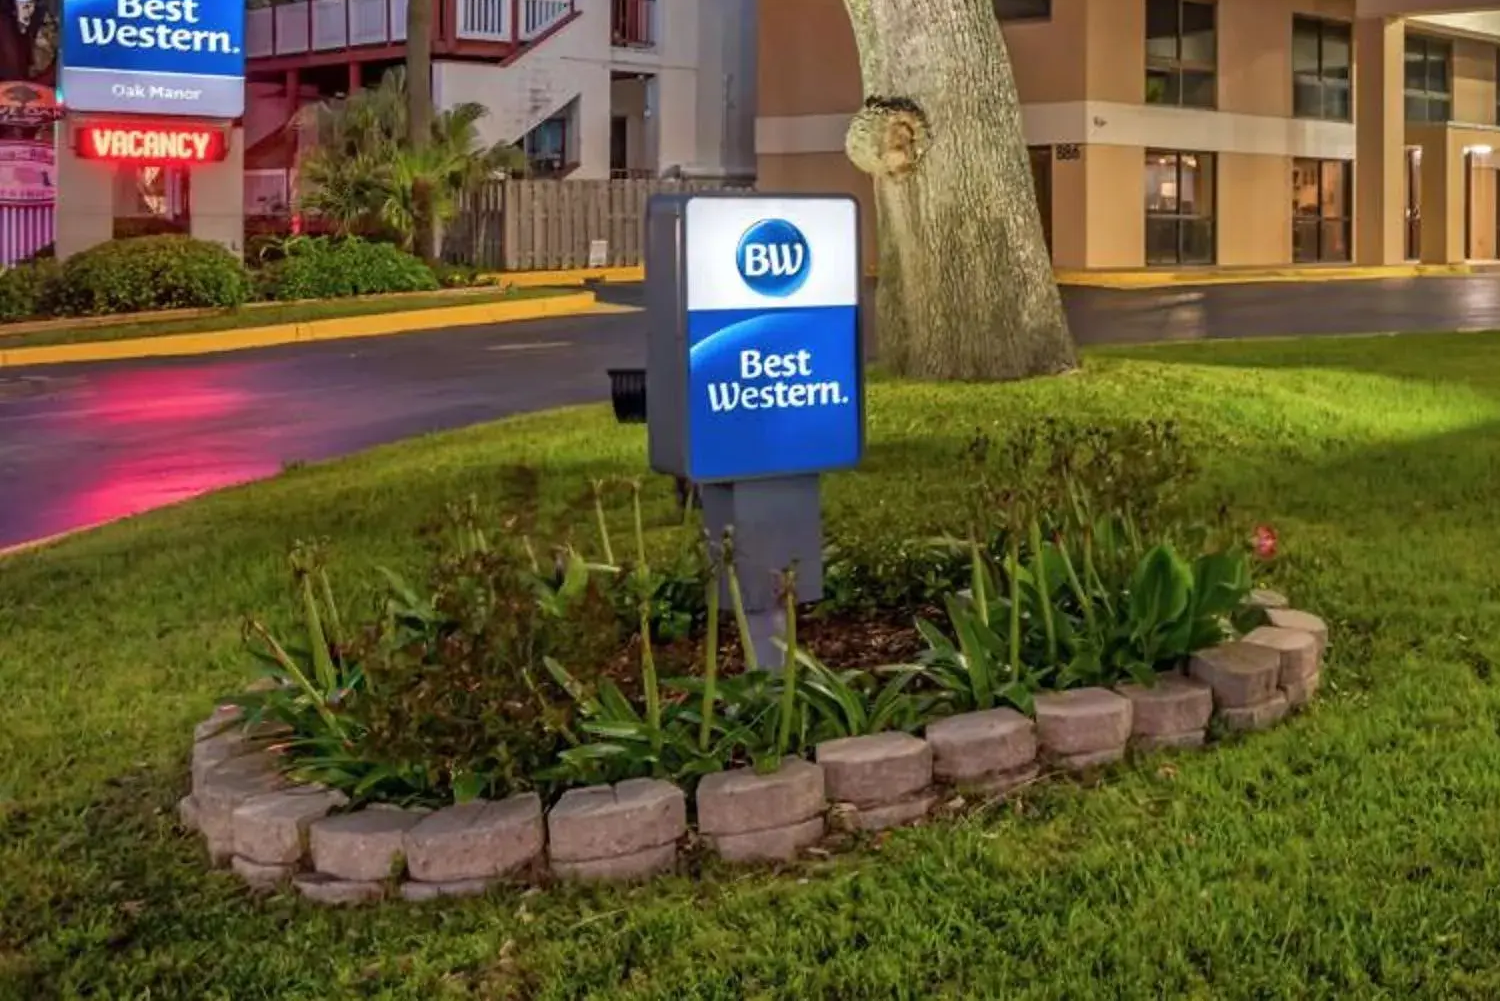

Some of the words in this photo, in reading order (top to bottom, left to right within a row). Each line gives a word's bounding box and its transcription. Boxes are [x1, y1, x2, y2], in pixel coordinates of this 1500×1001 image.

[112, 83, 145, 98] Oak
[150, 86, 202, 100] Manor
[92, 128, 210, 160] VACANCY
[745, 244, 803, 276] BW
[740, 350, 812, 379] Best
